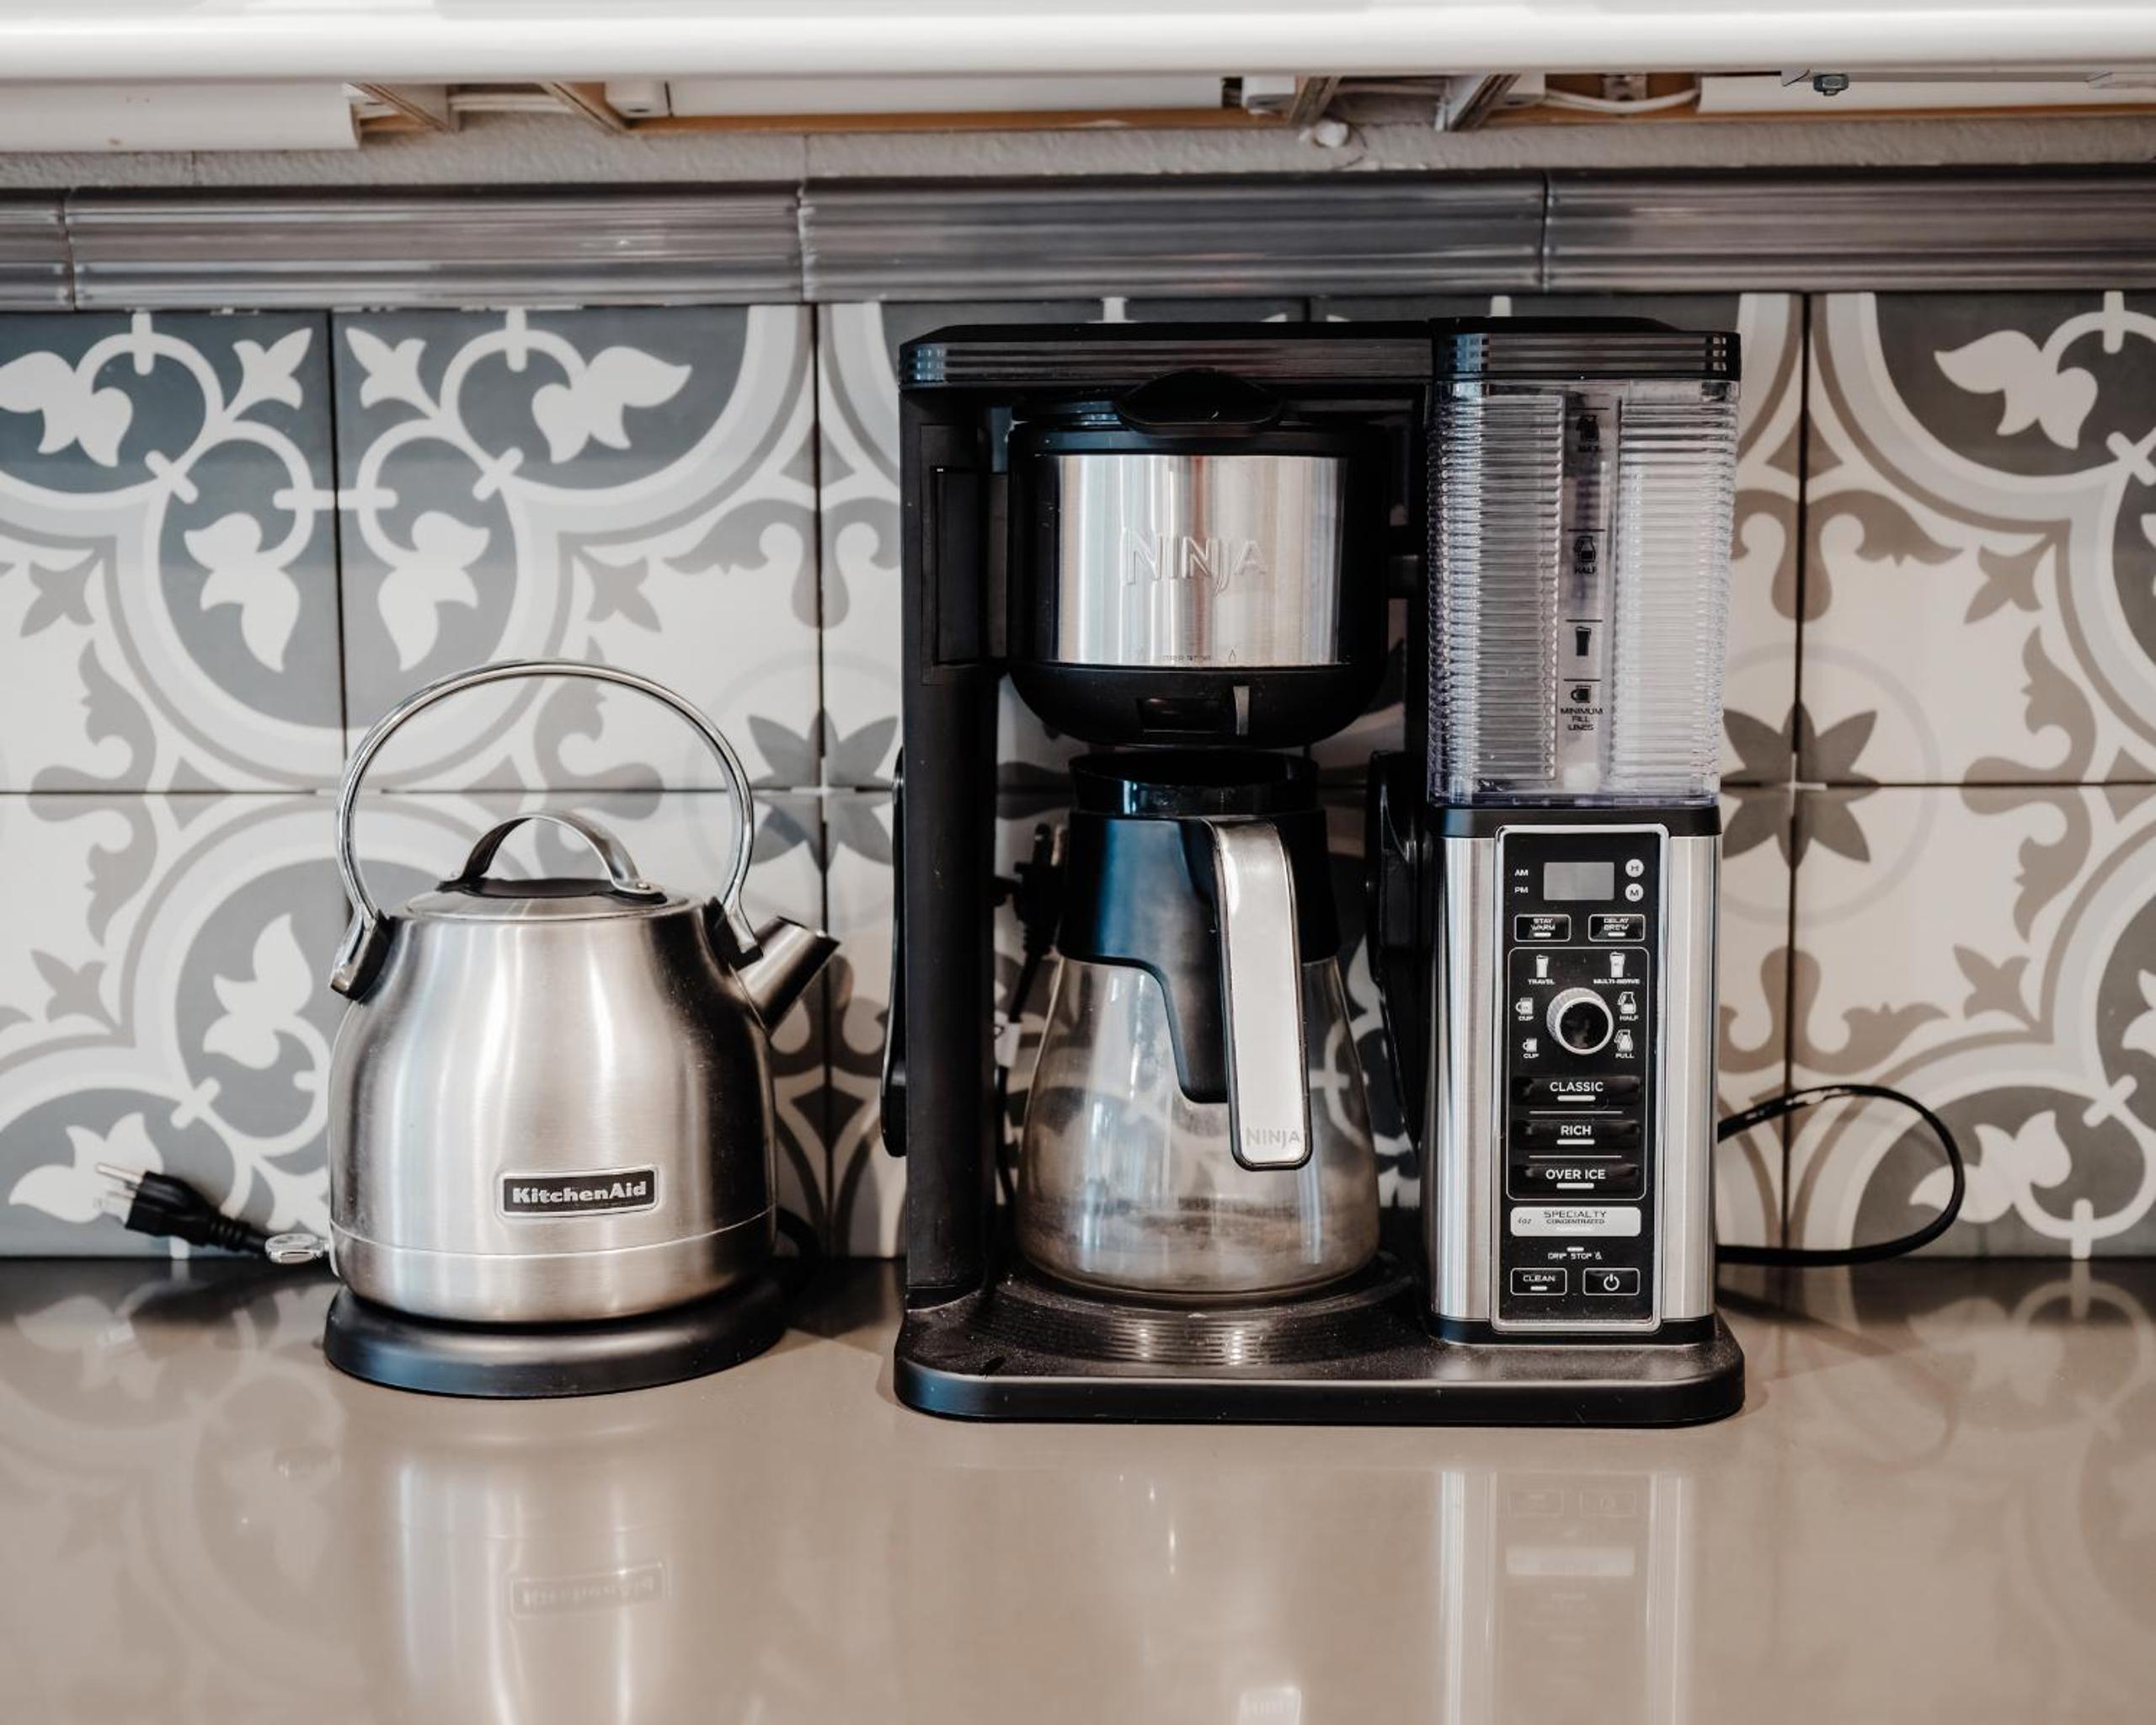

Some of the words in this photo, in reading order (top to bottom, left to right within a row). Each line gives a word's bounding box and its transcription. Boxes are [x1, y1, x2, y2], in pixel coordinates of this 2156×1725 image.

[1120, 526, 1267, 596] NINJA
[1550, 1081, 1604, 1092] CLASSIC
[1561, 1124, 1592, 1136] RICH
[1246, 1127, 1300, 1150] NINJA
[1545, 1169, 1582, 1179] OVER
[1584, 1169, 1606, 1179] ICE
[512, 1181, 646, 1203] KitchenAid
[1544, 1210, 1606, 1219] SPECIALTY
